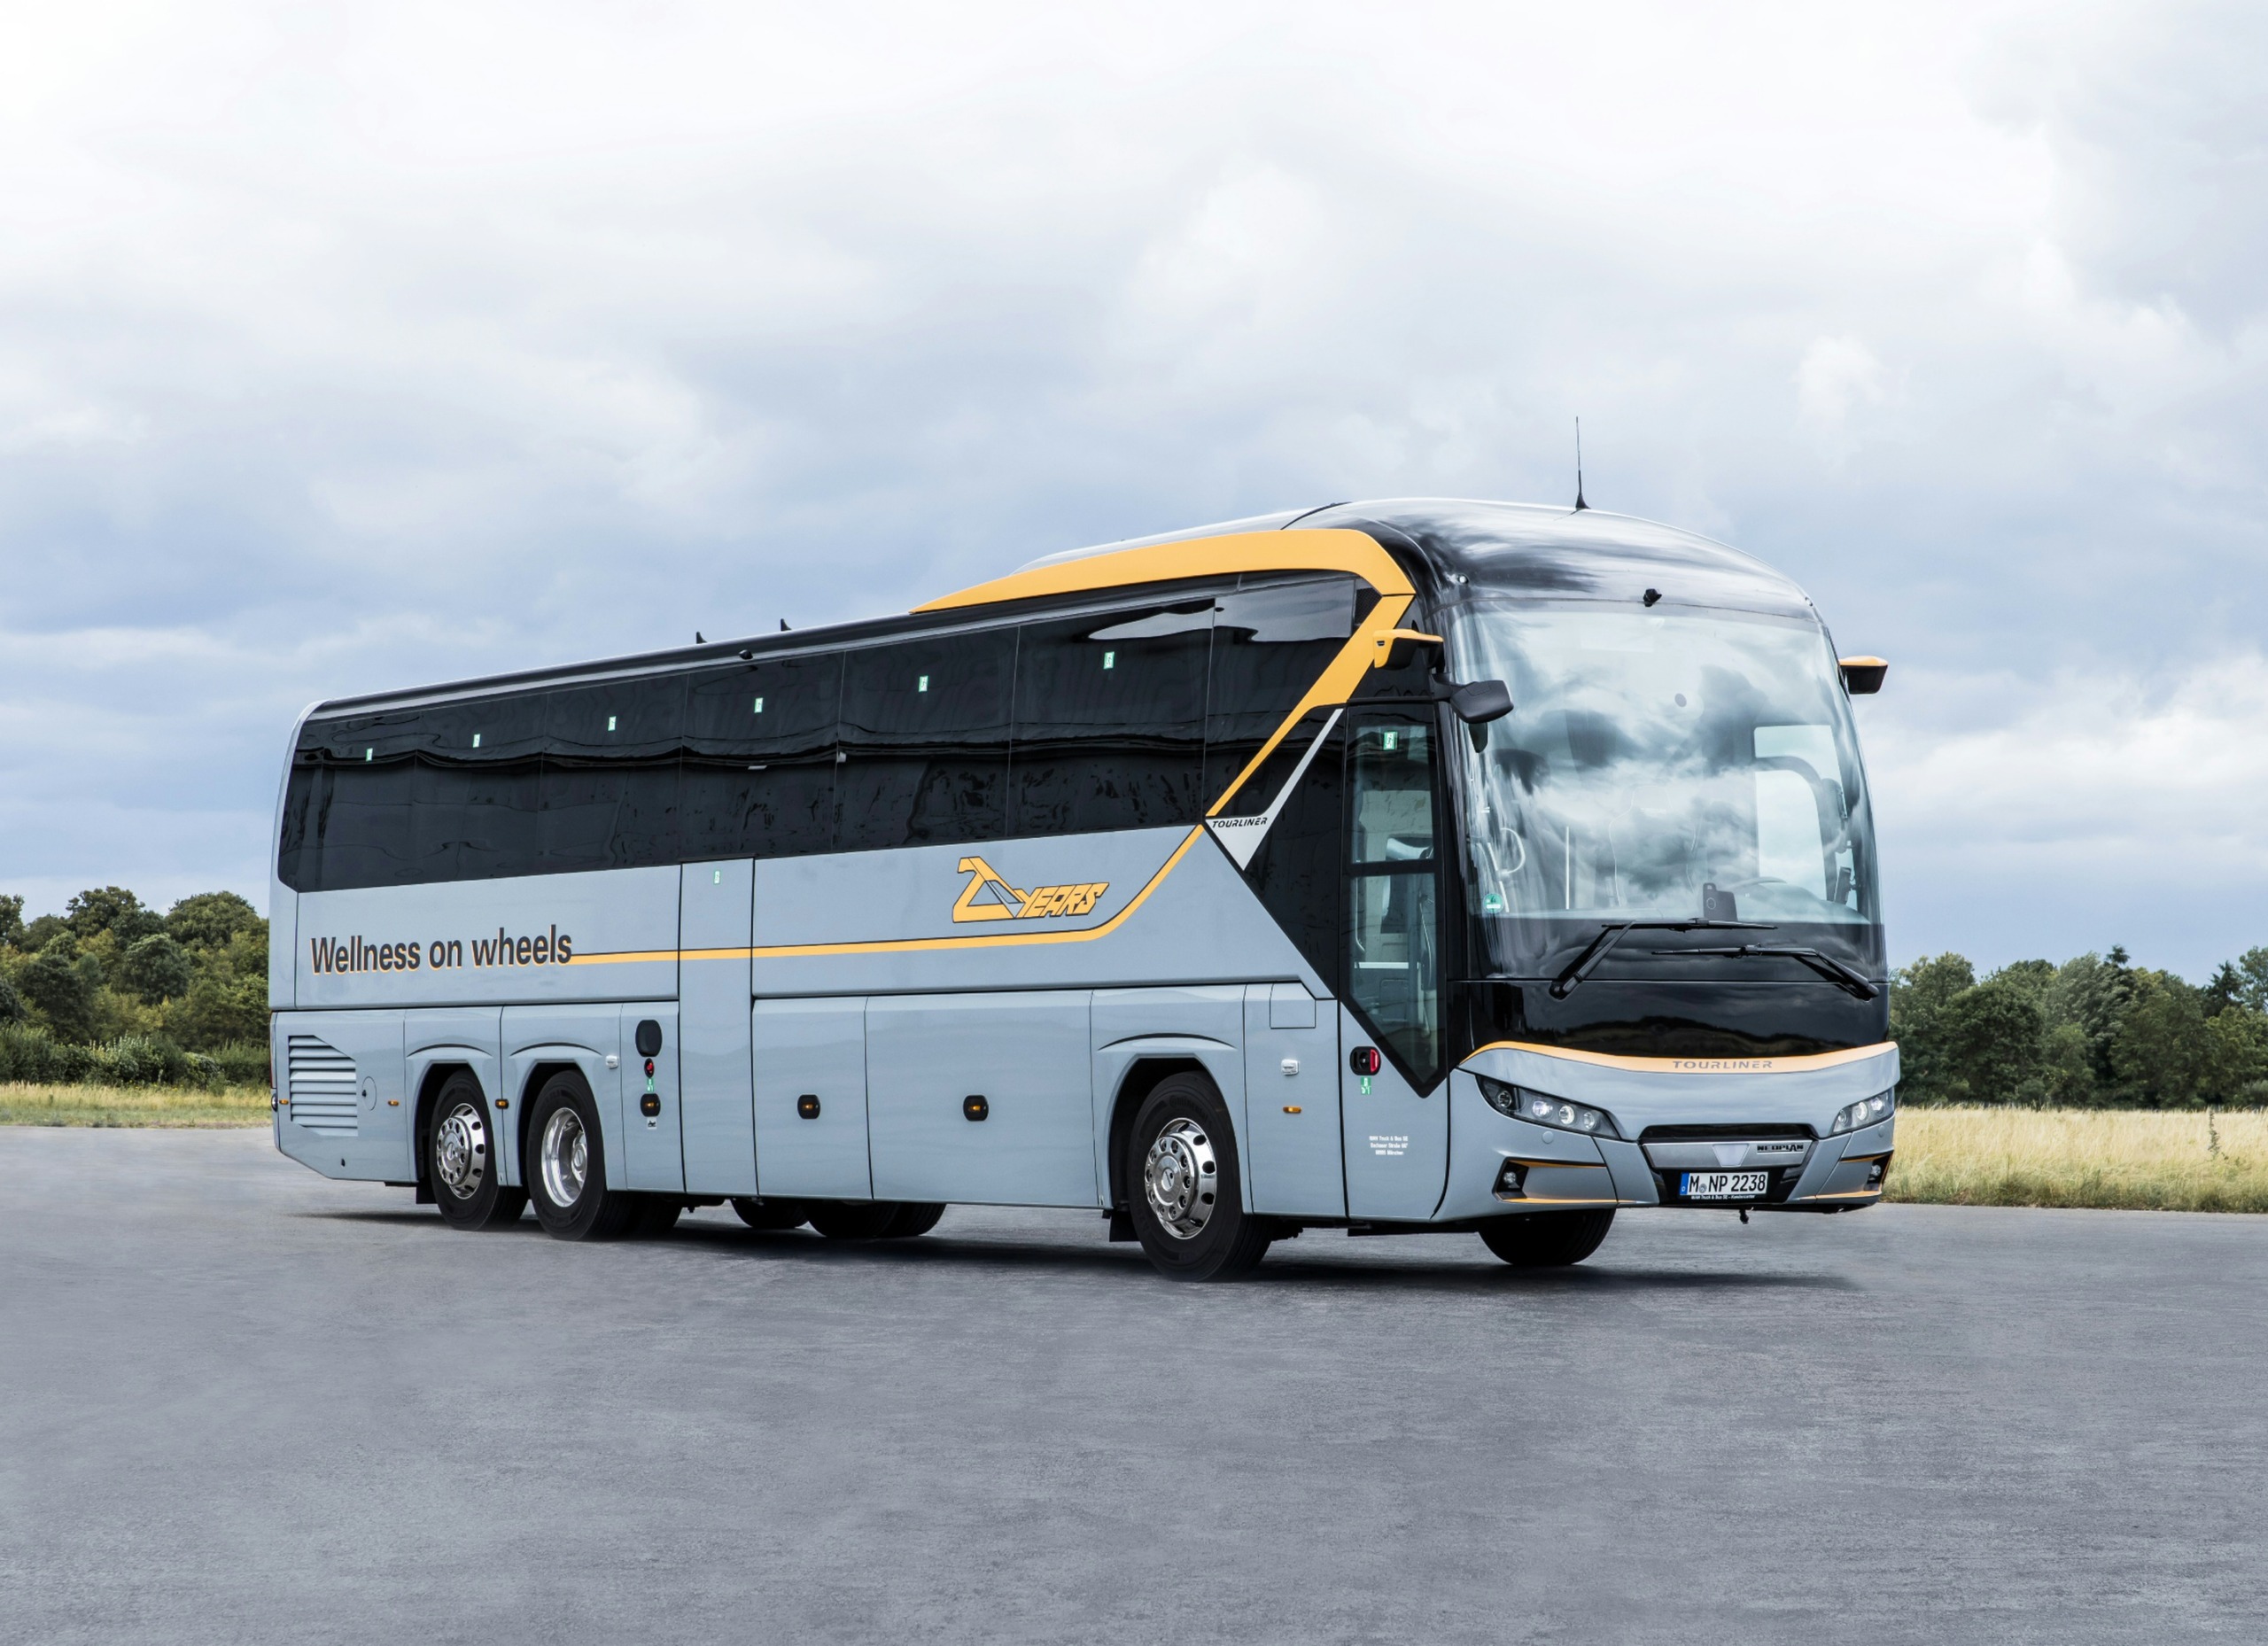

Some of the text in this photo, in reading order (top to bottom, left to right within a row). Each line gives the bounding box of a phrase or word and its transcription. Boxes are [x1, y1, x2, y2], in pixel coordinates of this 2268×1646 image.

[1212, 817, 1268, 828] TOURLINER
[1013, 881, 1110, 920] YEARS
[310, 924, 572, 974] Wellness on wheels
[1672, 1060, 1773, 1069] TOURLINER
[1689, 1174, 1766, 1192] M NP 2238
